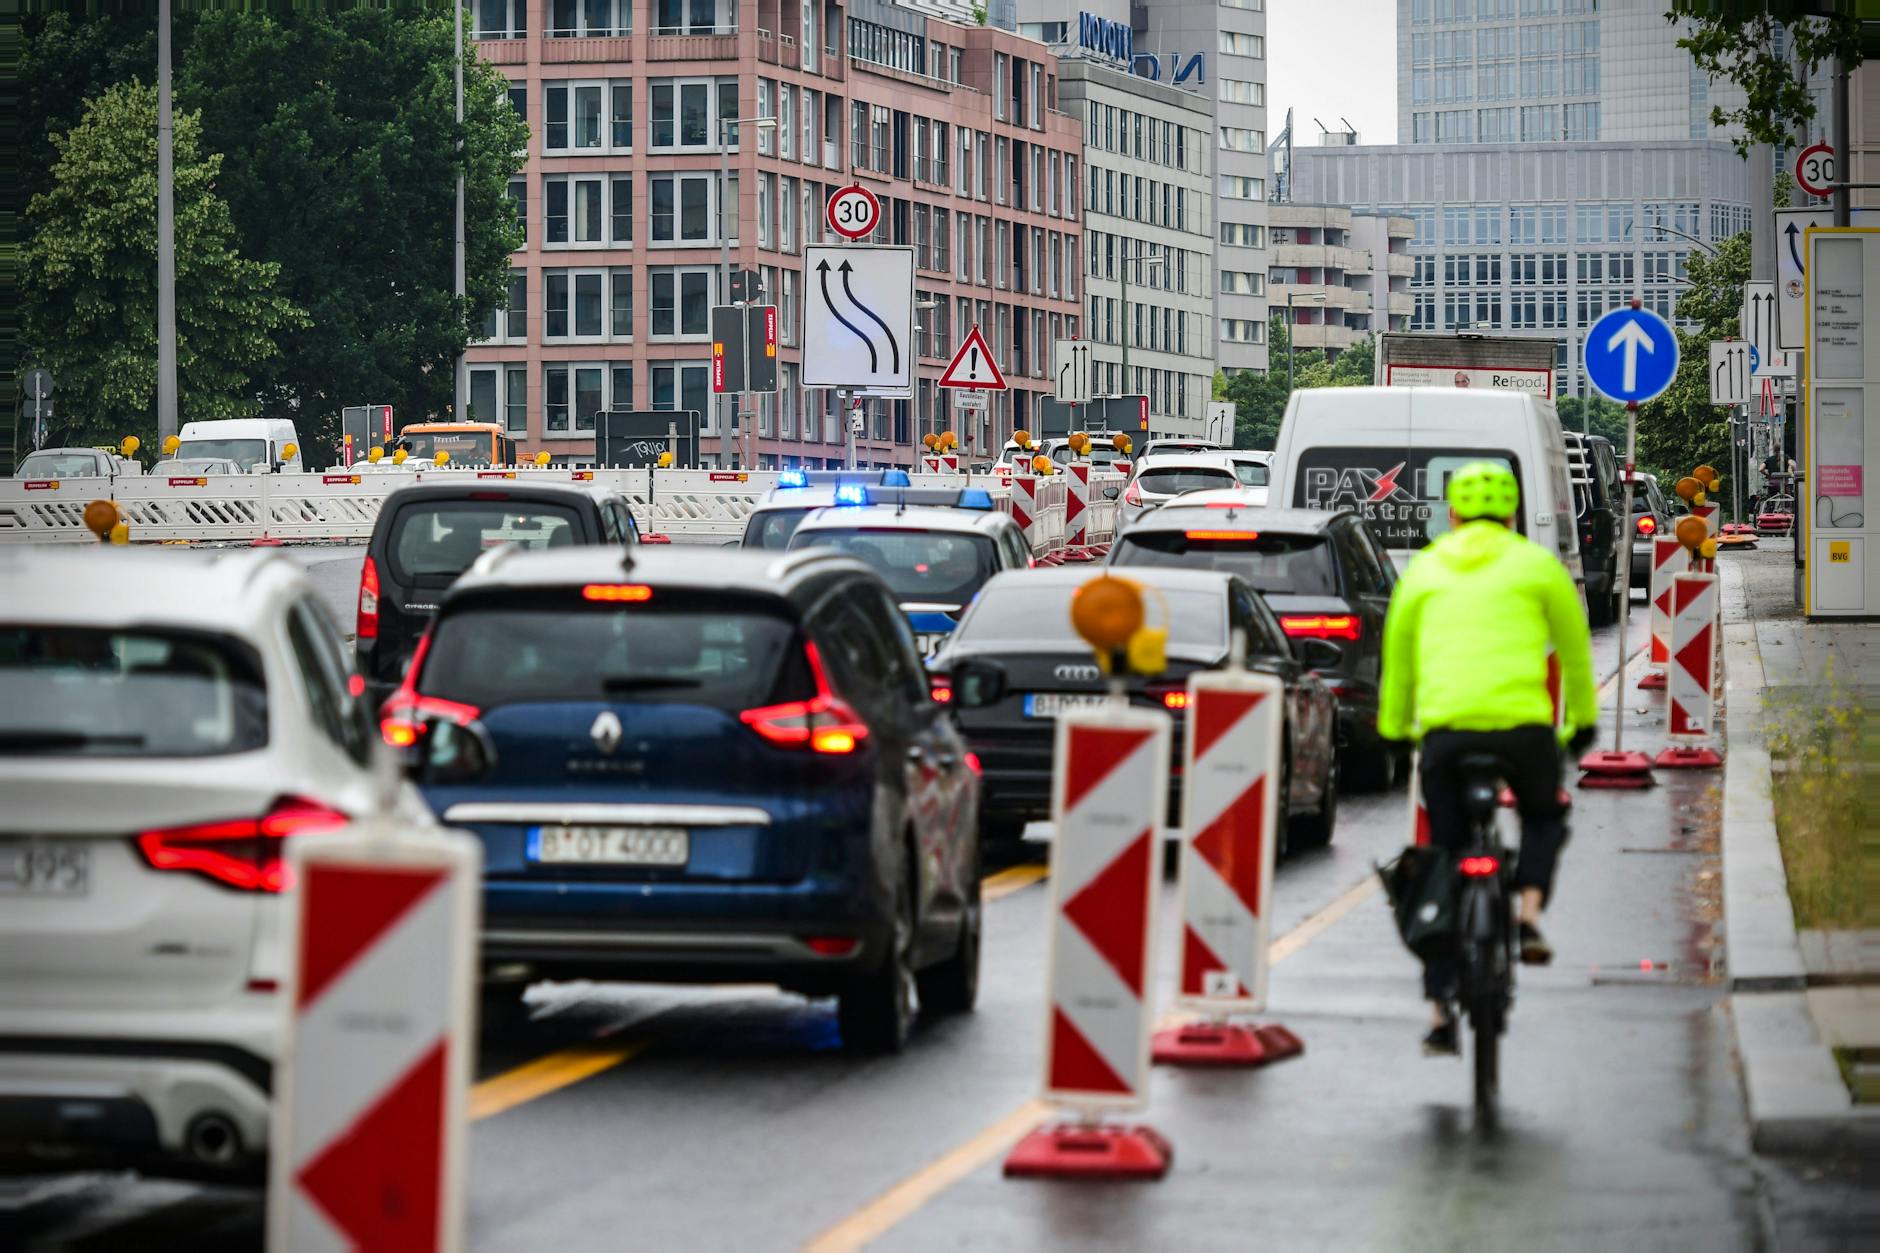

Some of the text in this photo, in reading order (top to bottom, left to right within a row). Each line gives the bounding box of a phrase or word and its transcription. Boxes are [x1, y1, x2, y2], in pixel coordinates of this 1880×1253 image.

[1806, 158, 1834, 182] 30
[838, 200, 869, 223] 30
[1492, 375, 1542, 388] ReFood
[1832, 551, 1849, 561] BVG
